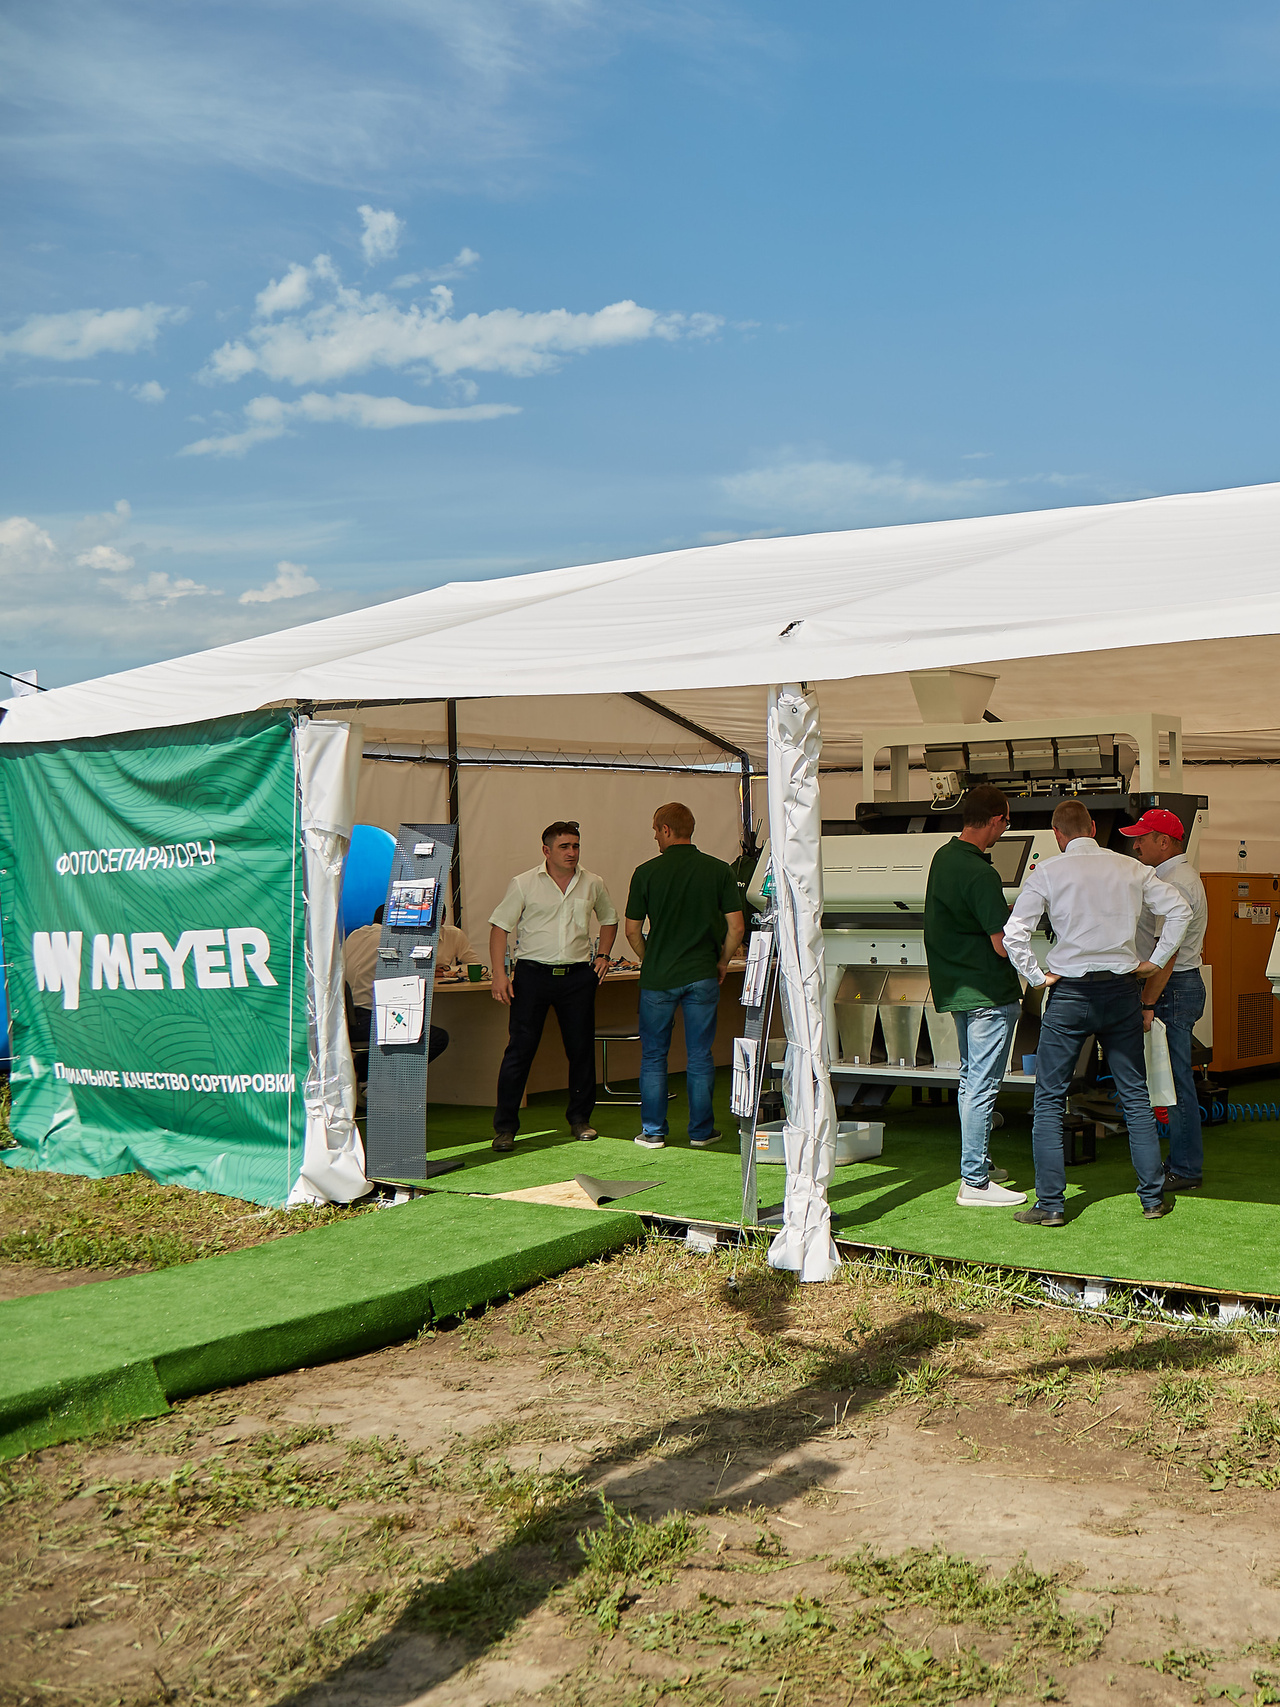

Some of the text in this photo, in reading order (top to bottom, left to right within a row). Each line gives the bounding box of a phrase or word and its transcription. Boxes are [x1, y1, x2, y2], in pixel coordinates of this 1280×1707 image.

[56, 840, 216, 876] ФОТОСЕПАРАТОРЫ
[92, 927, 279, 990] MEYER
[54, 1062, 295, 1093] ПИАЛЬНОЕ КАЧЕСТВО СОРТИРОВКИ
